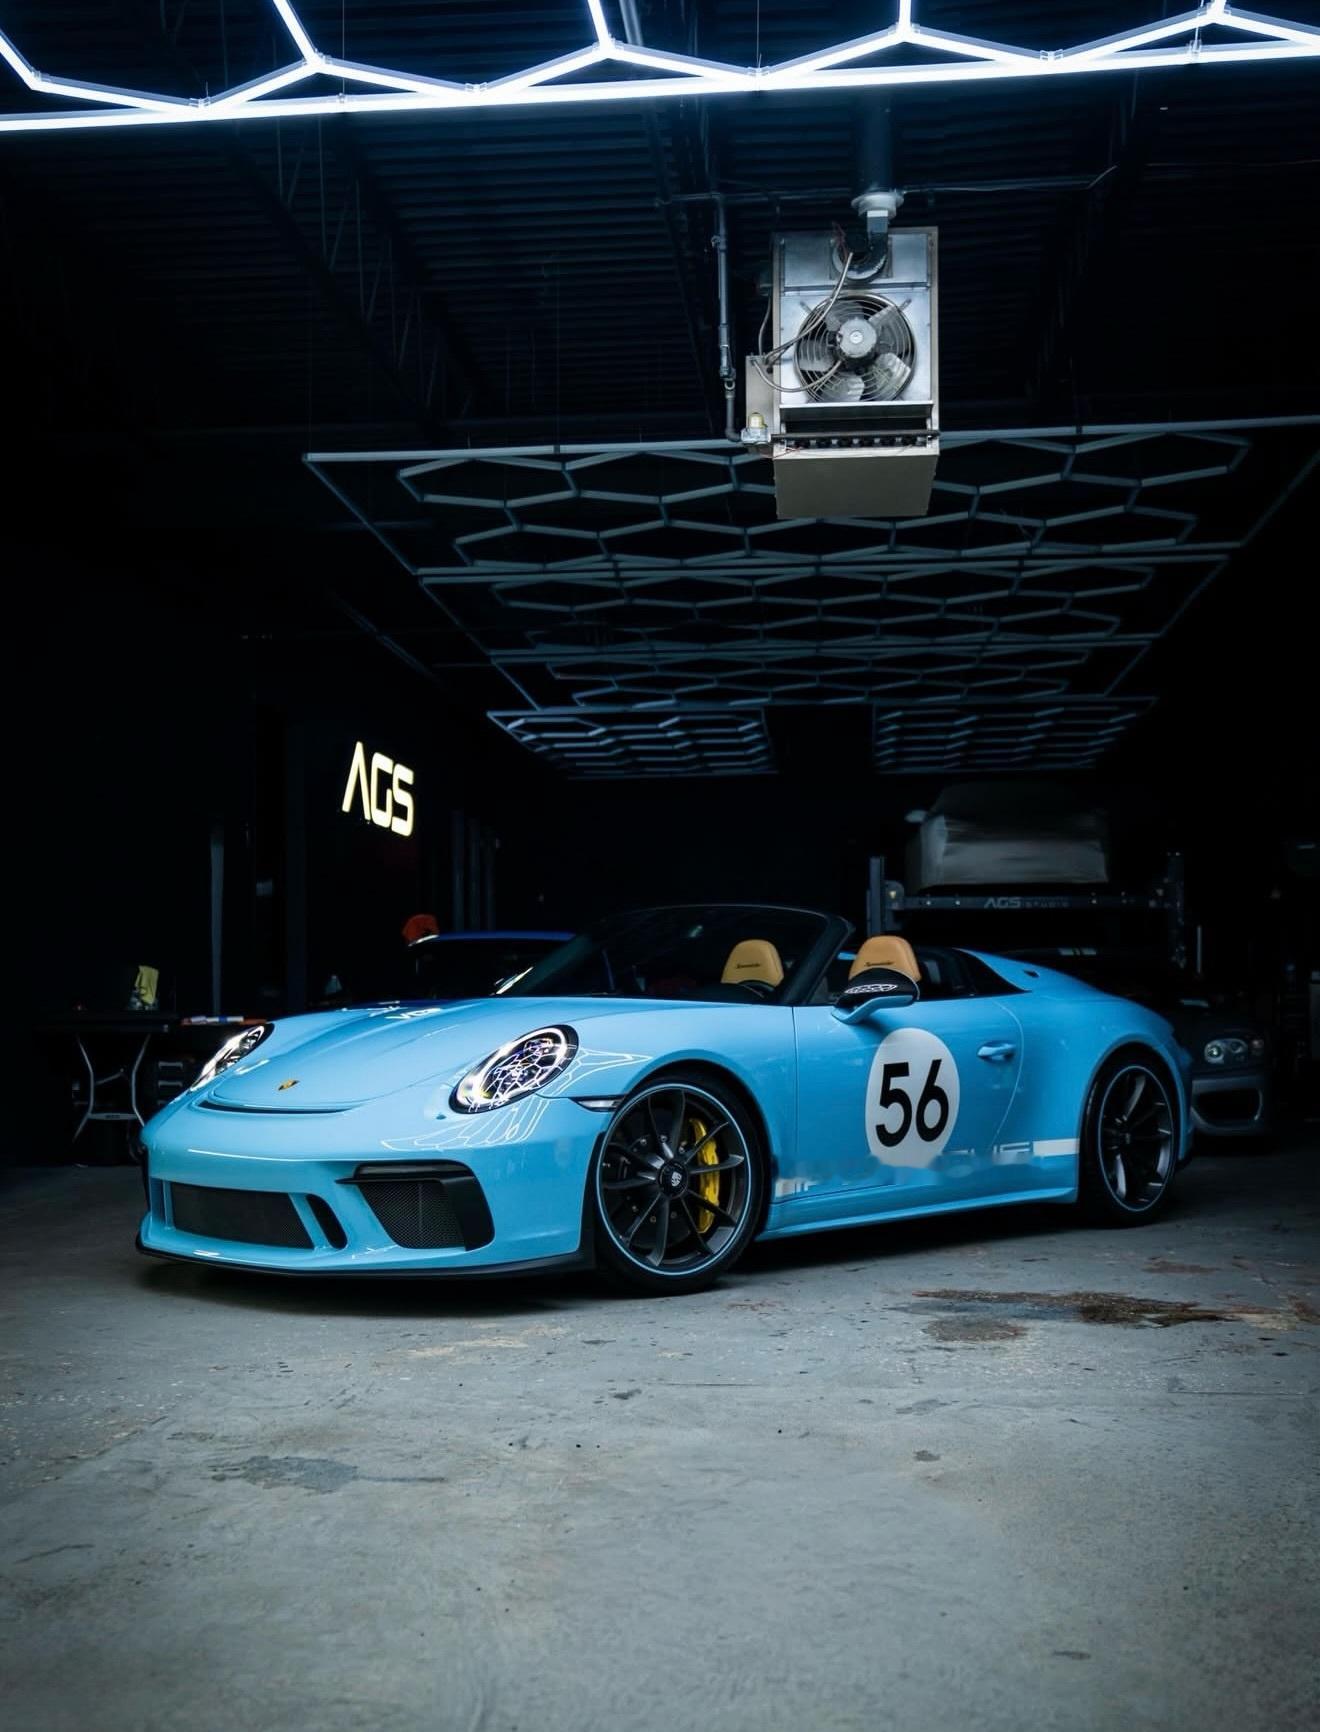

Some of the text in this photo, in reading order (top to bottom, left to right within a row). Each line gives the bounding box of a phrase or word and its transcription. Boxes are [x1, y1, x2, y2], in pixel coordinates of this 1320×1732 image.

[342, 741, 414, 837] AGS
[984, 896, 1022, 909] AGS
[876, 1059, 949, 1147] 56
